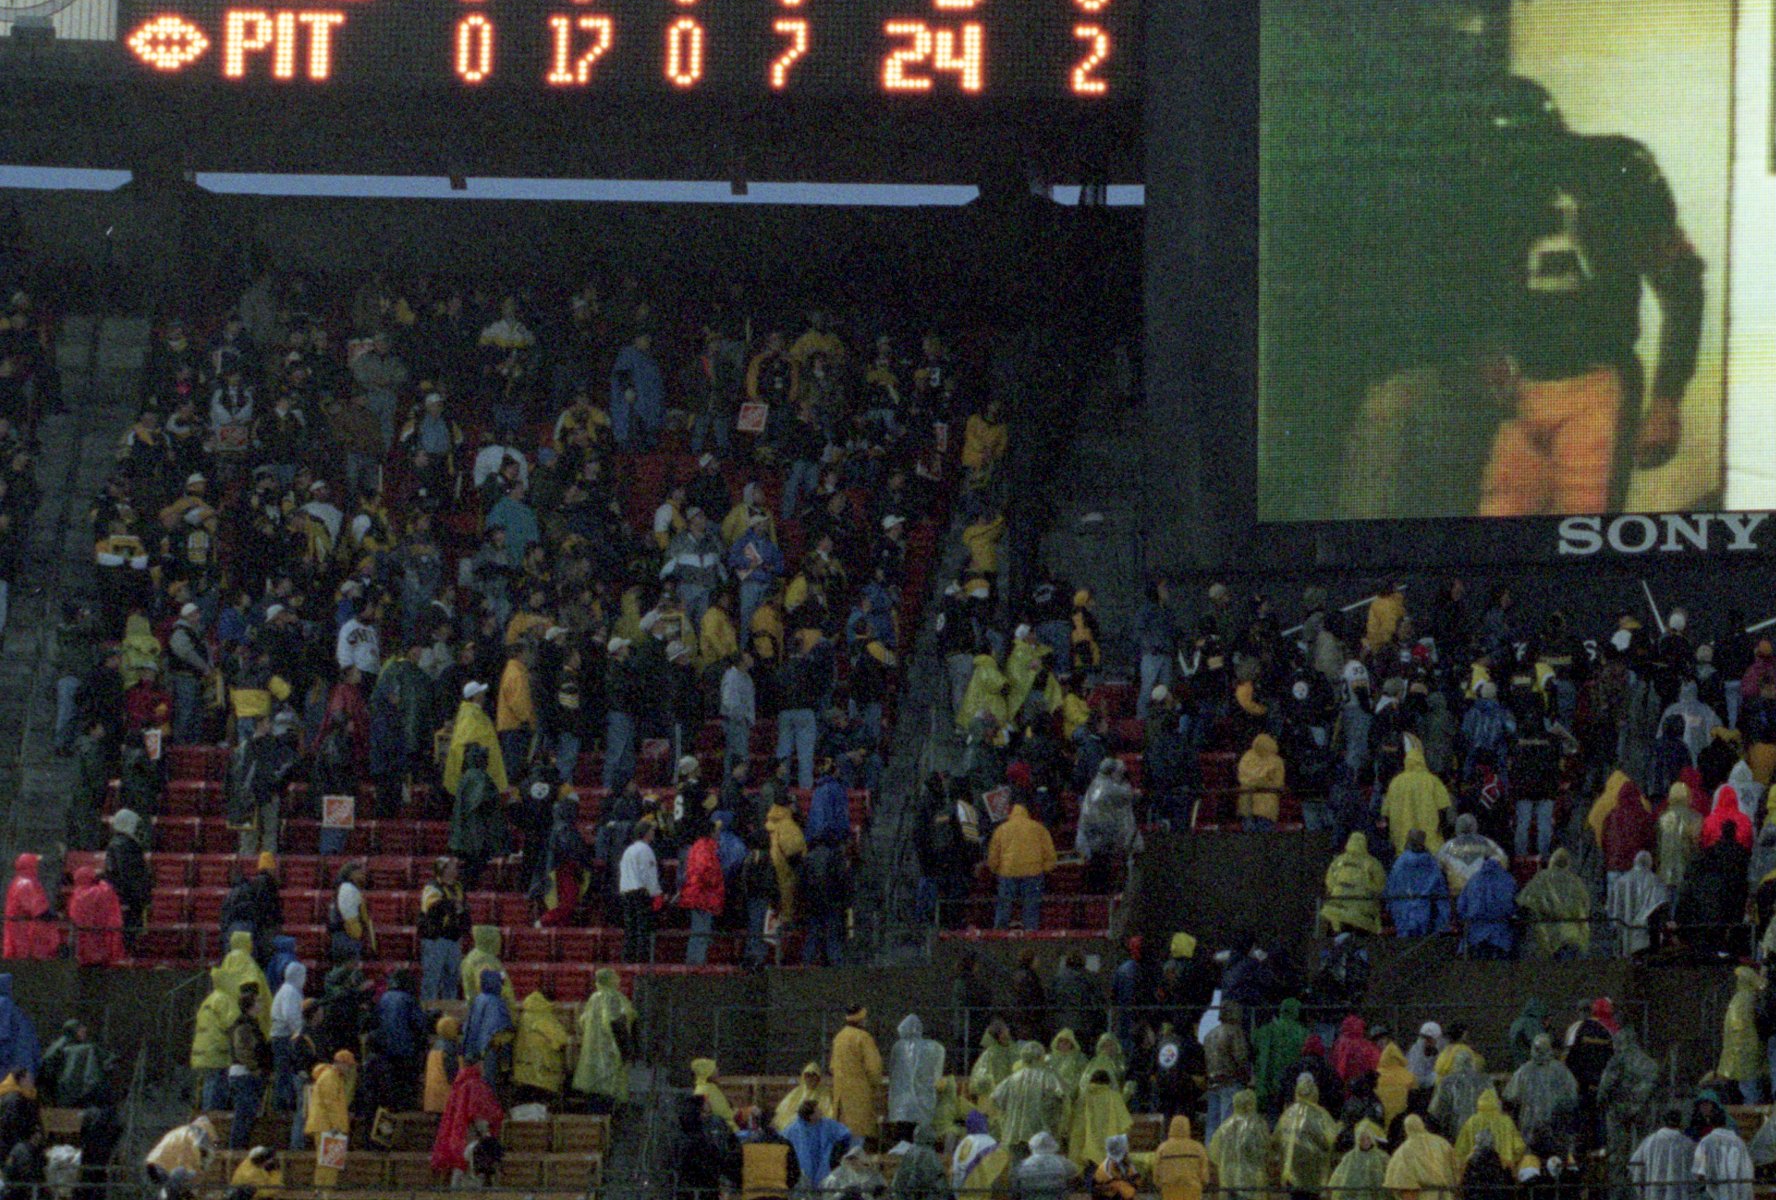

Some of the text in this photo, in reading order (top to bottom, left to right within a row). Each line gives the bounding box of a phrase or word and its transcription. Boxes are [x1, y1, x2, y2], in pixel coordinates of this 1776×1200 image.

[221, 7, 1111, 95] PIT 0 17 0 7 24 2
[1557, 513, 1769, 554] SONY
